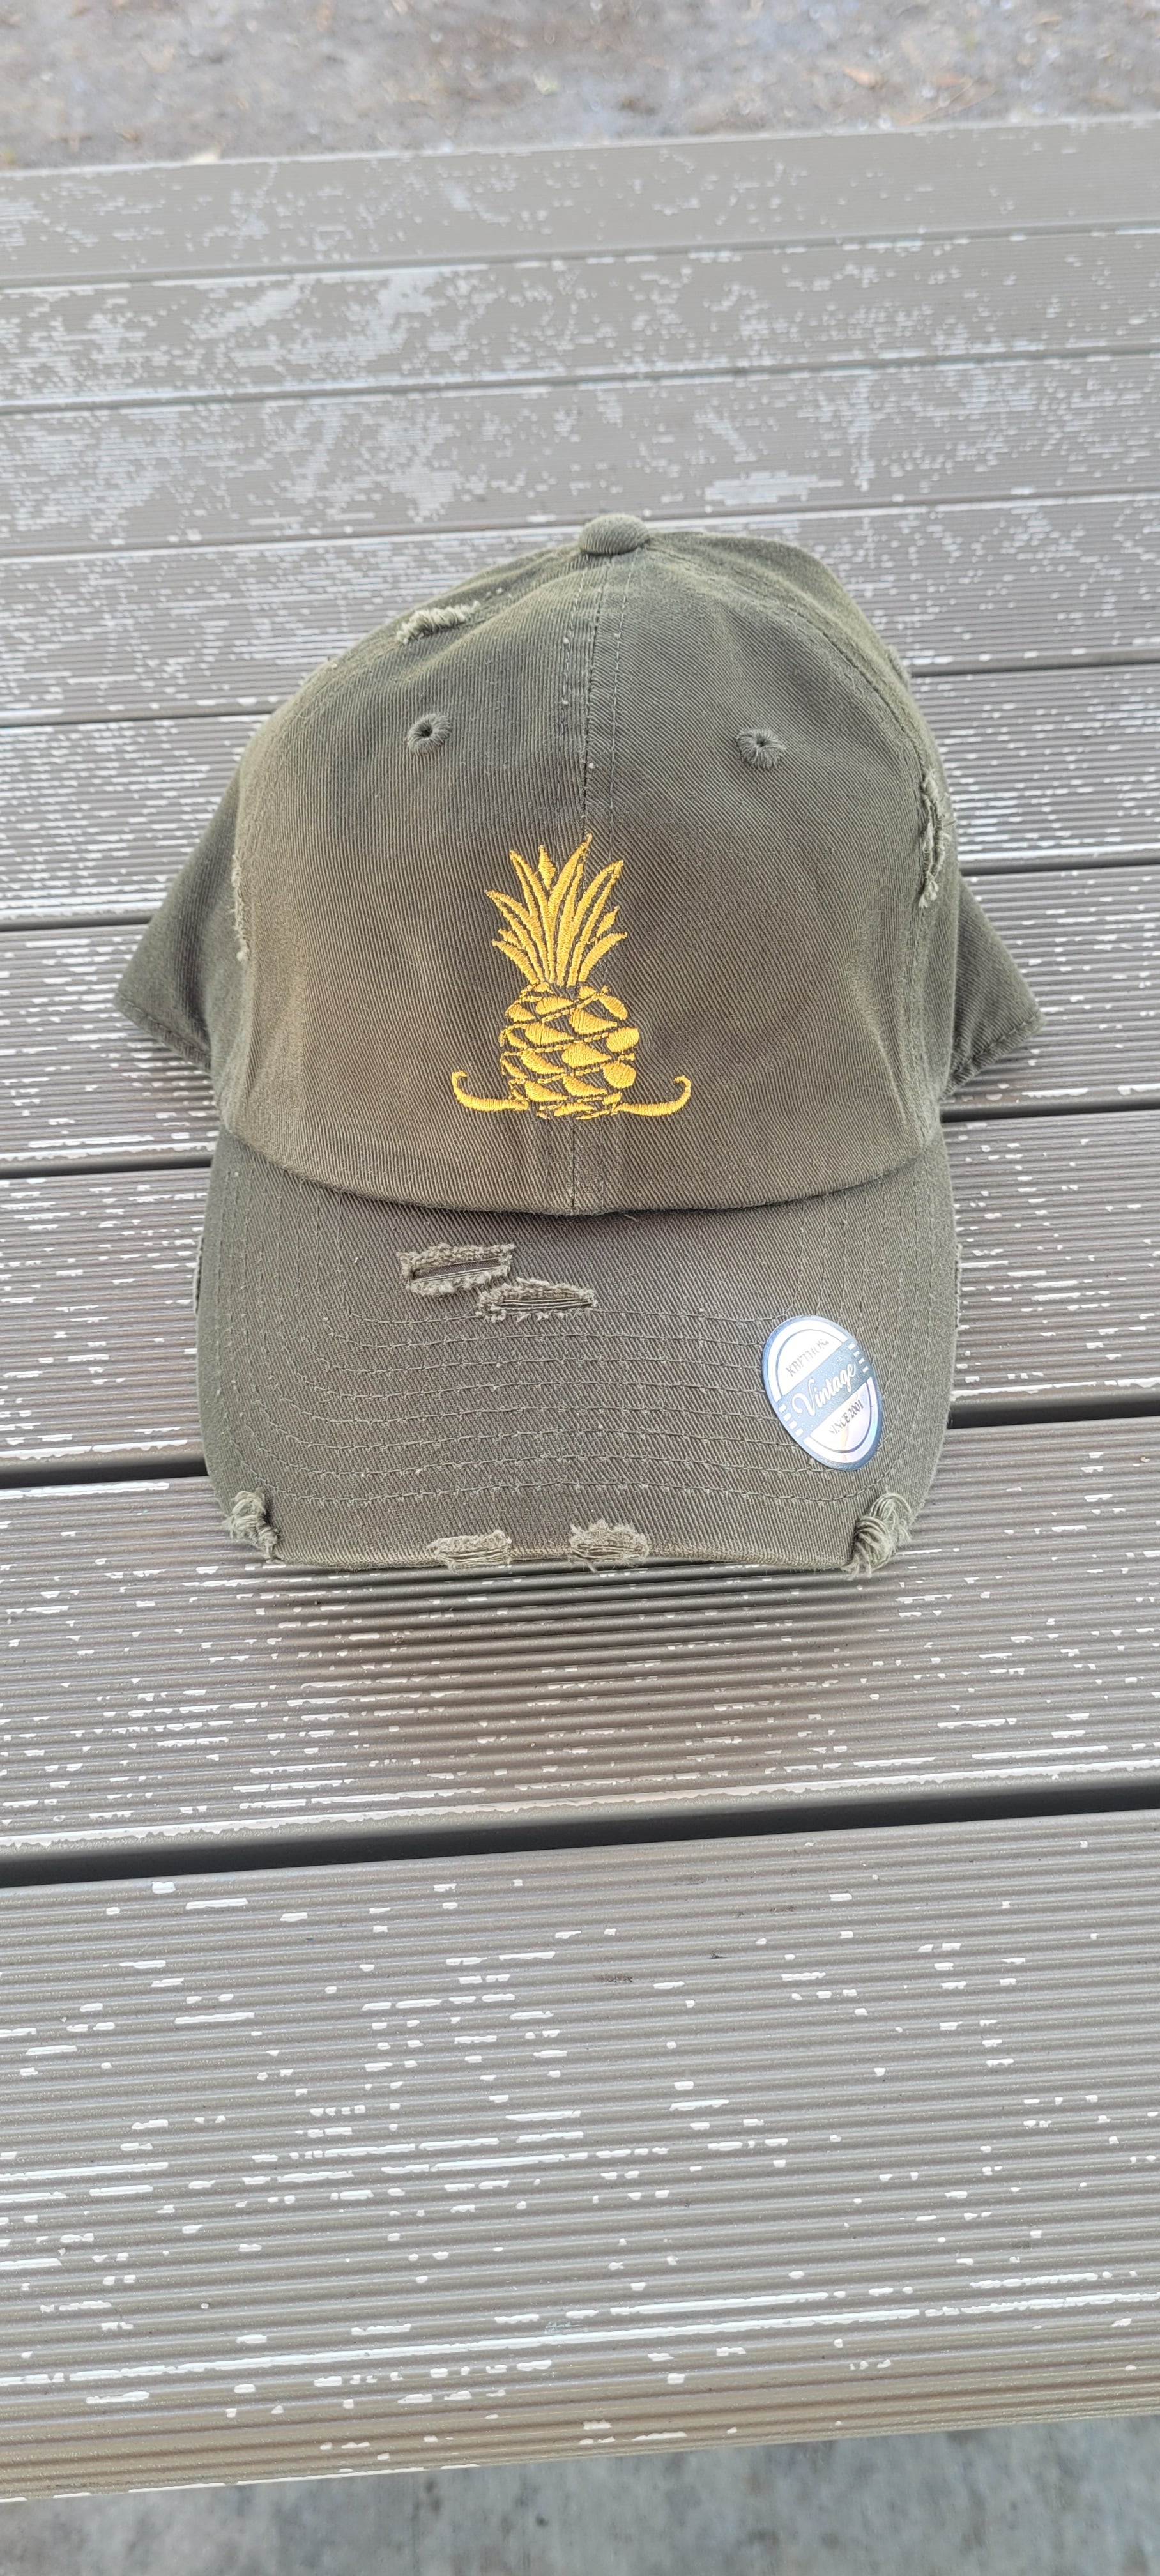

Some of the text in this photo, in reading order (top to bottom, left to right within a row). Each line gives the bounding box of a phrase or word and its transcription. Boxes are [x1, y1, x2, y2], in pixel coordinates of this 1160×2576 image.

[791, 1363, 856, 1416] Vintage
[829, 1399, 864, 1434] SINCE 2001
